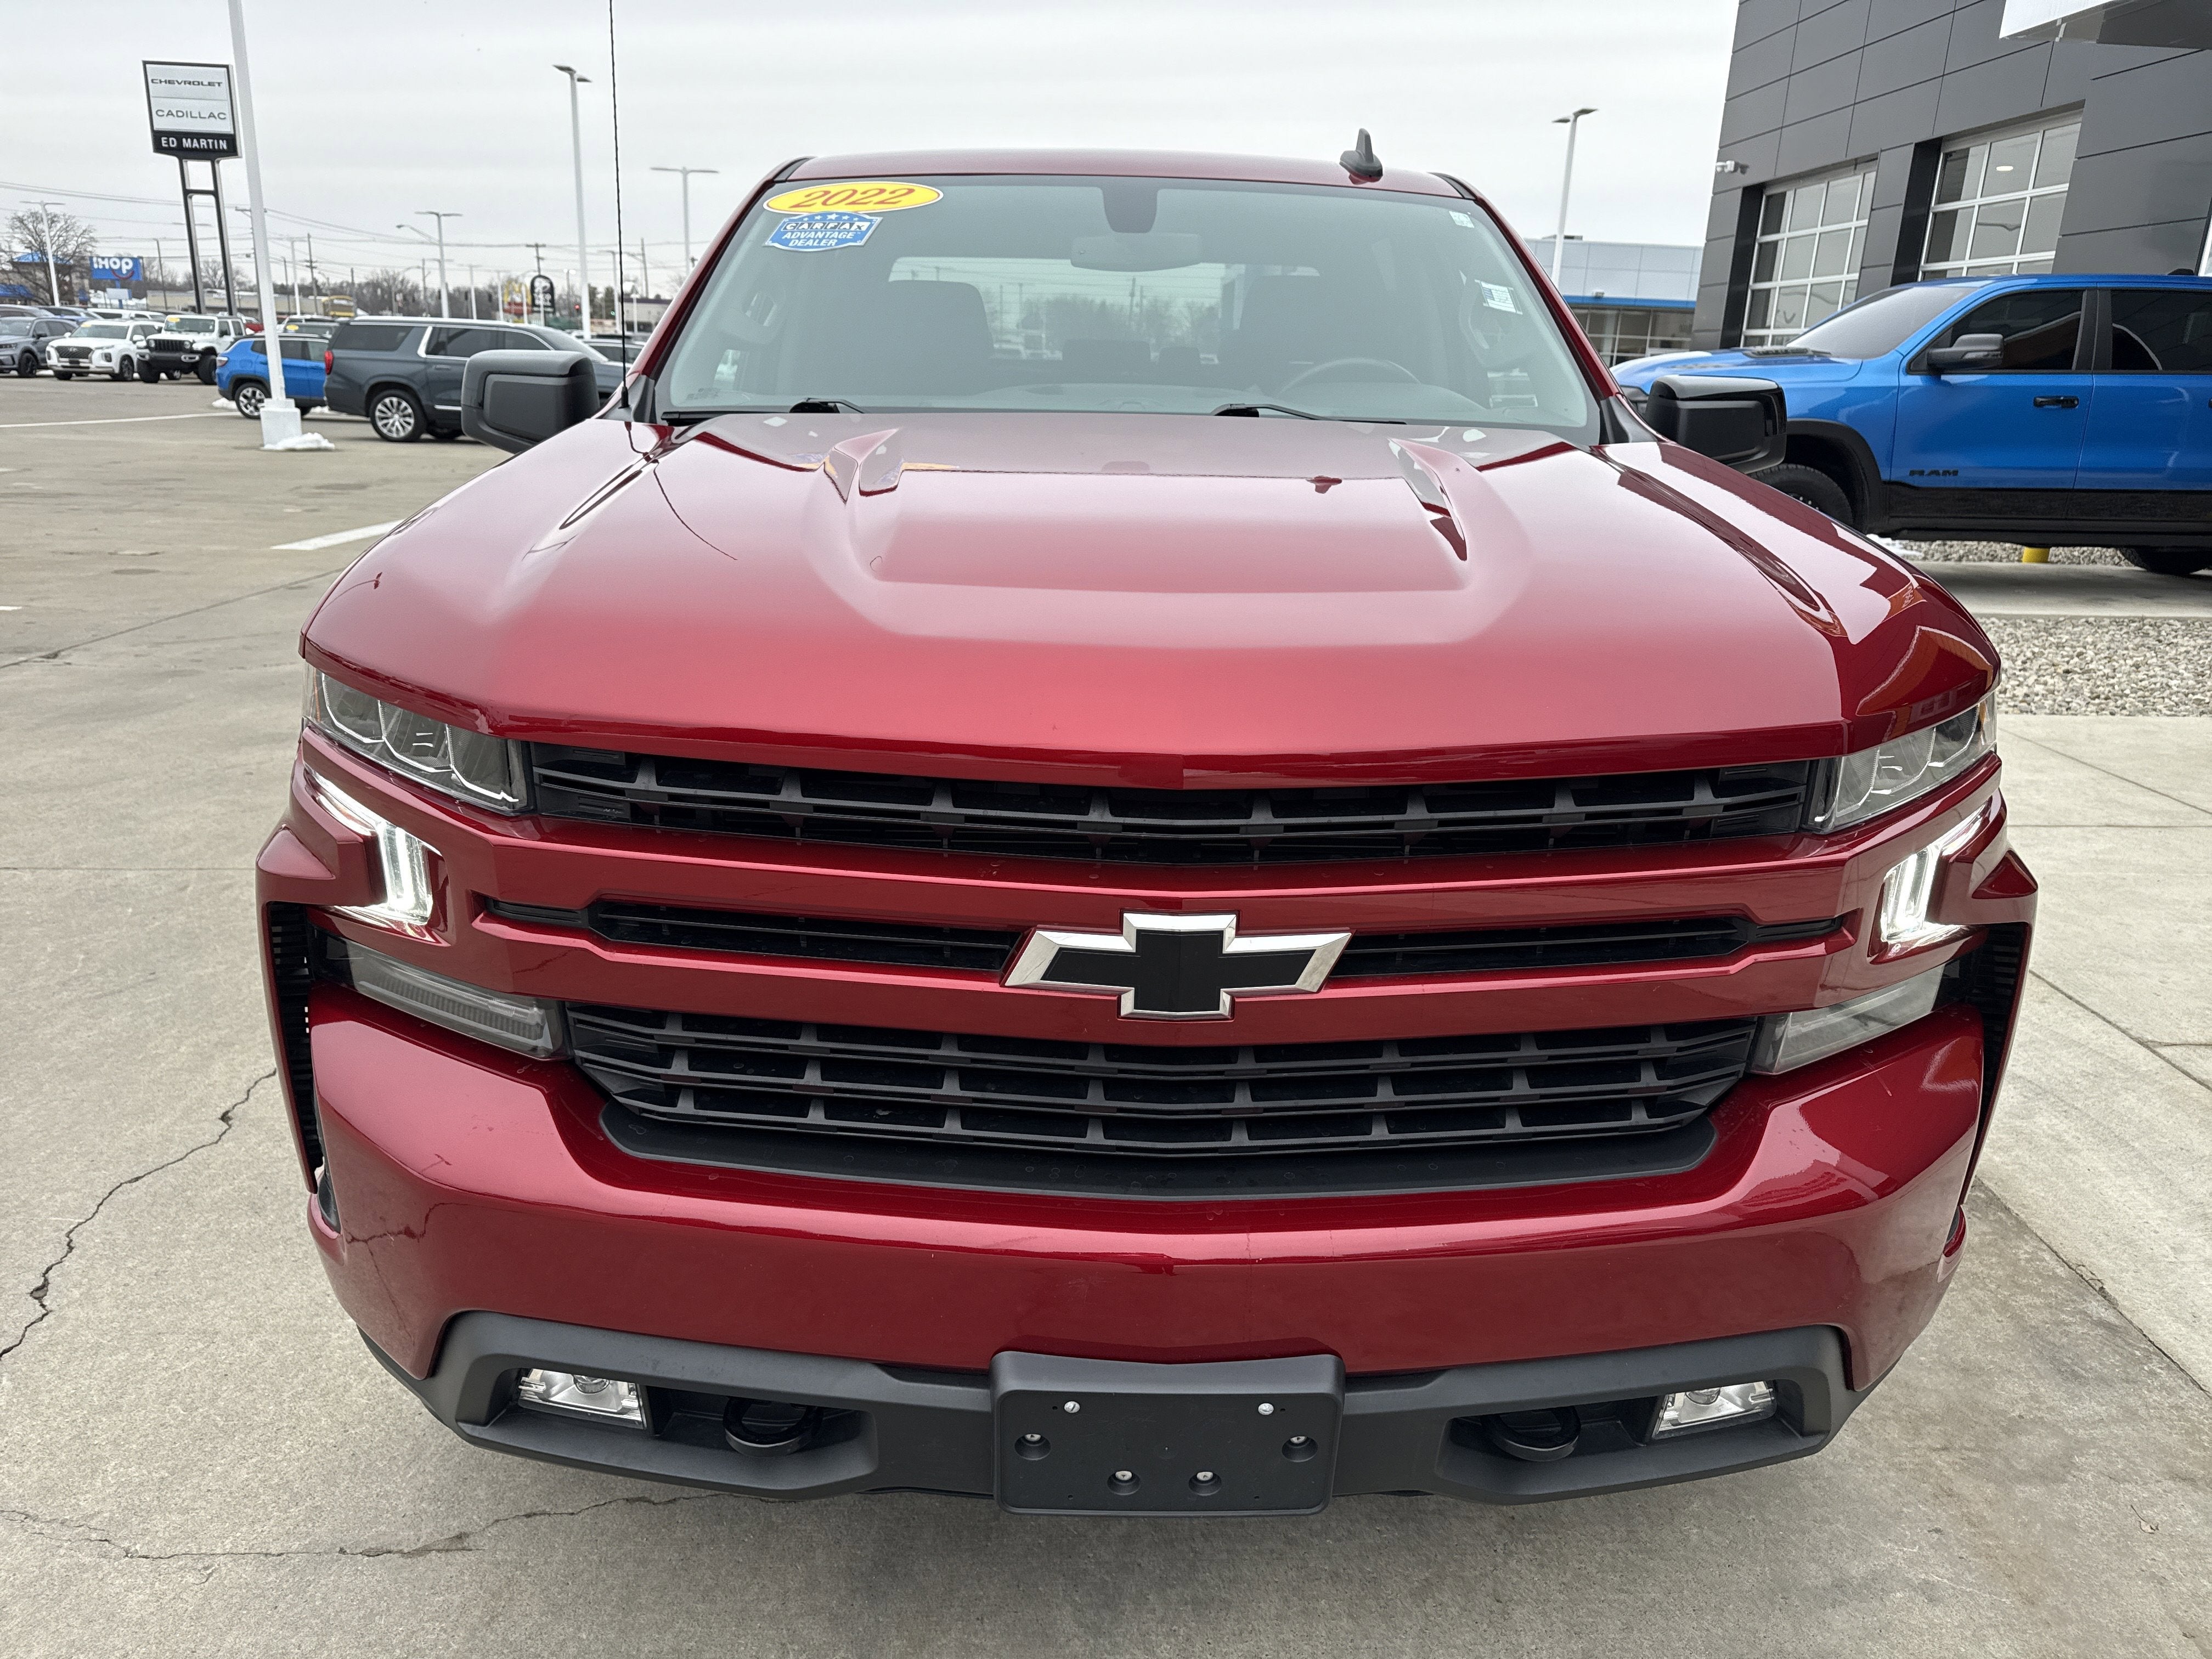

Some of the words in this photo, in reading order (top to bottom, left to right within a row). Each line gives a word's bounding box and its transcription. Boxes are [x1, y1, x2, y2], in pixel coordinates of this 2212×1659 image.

[151, 78, 222, 87] CHEVROLET
[156, 109, 227, 120] CADILLAC
[161, 137, 177, 148] ED
[182, 138, 227, 150] MARTIN
[788, 188, 916, 208] 2022
[785, 222, 865, 230] CARFAX
